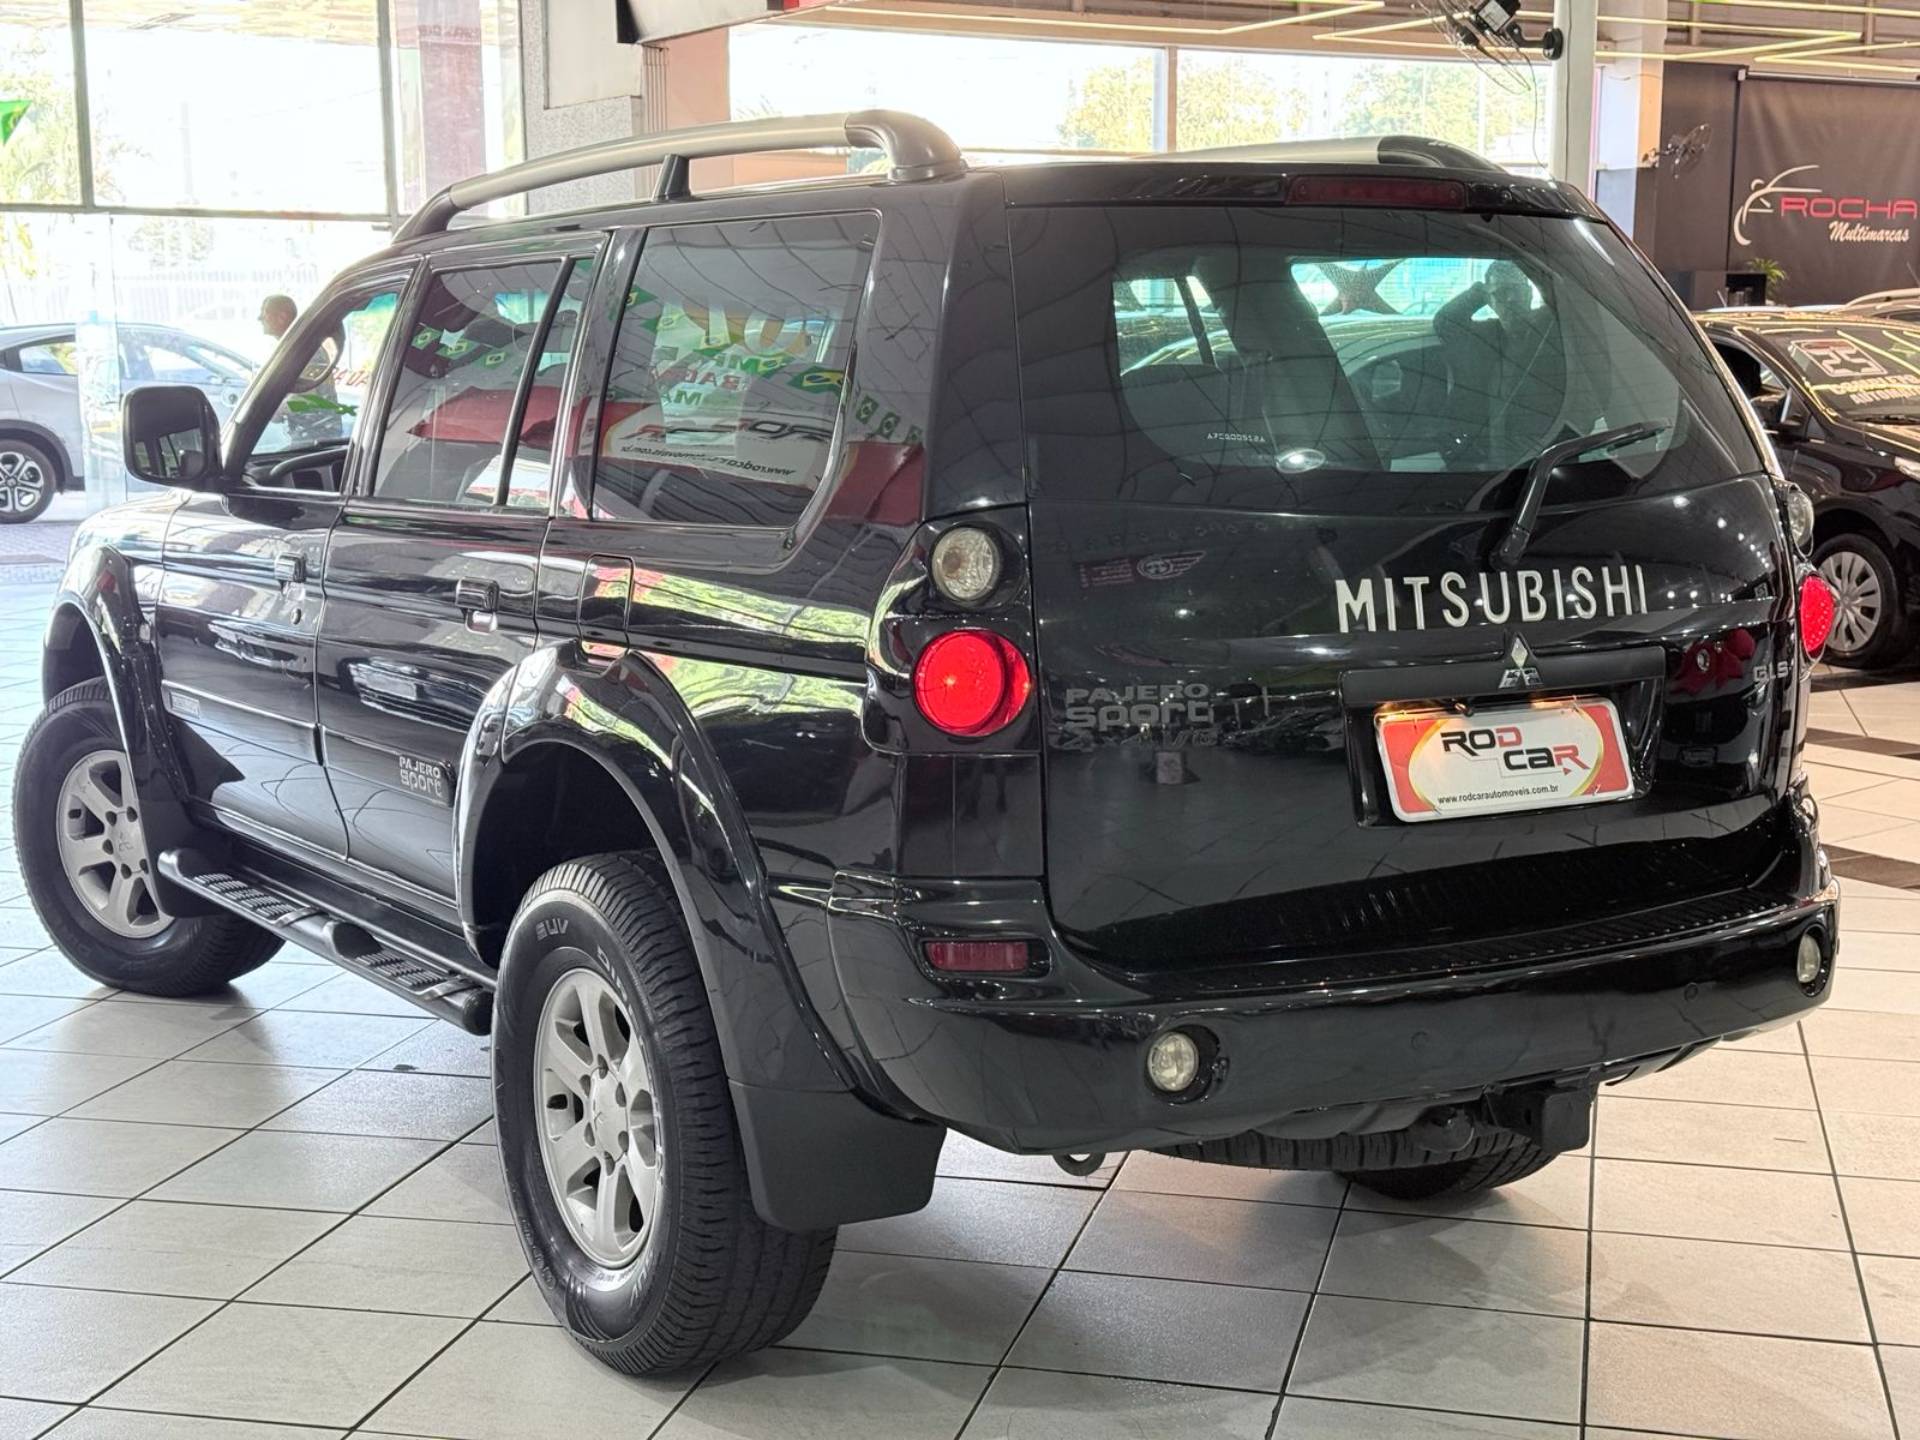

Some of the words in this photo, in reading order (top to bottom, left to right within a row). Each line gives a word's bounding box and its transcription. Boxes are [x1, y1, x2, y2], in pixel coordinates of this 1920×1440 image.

[1780, 197, 1917, 220] ROCHA
[1828, 220, 1909, 242] Multimarcas
[1335, 564, 1649, 633] MITSUBISHI
[1753, 661, 1789, 682] GLS
[1065, 683, 1209, 705] PAJERO
[1440, 726, 1522, 756] ROD
[400, 756, 441, 779] PAJERO
[1438, 784, 1559, 805] www.rodcarautomoveis.com.br
